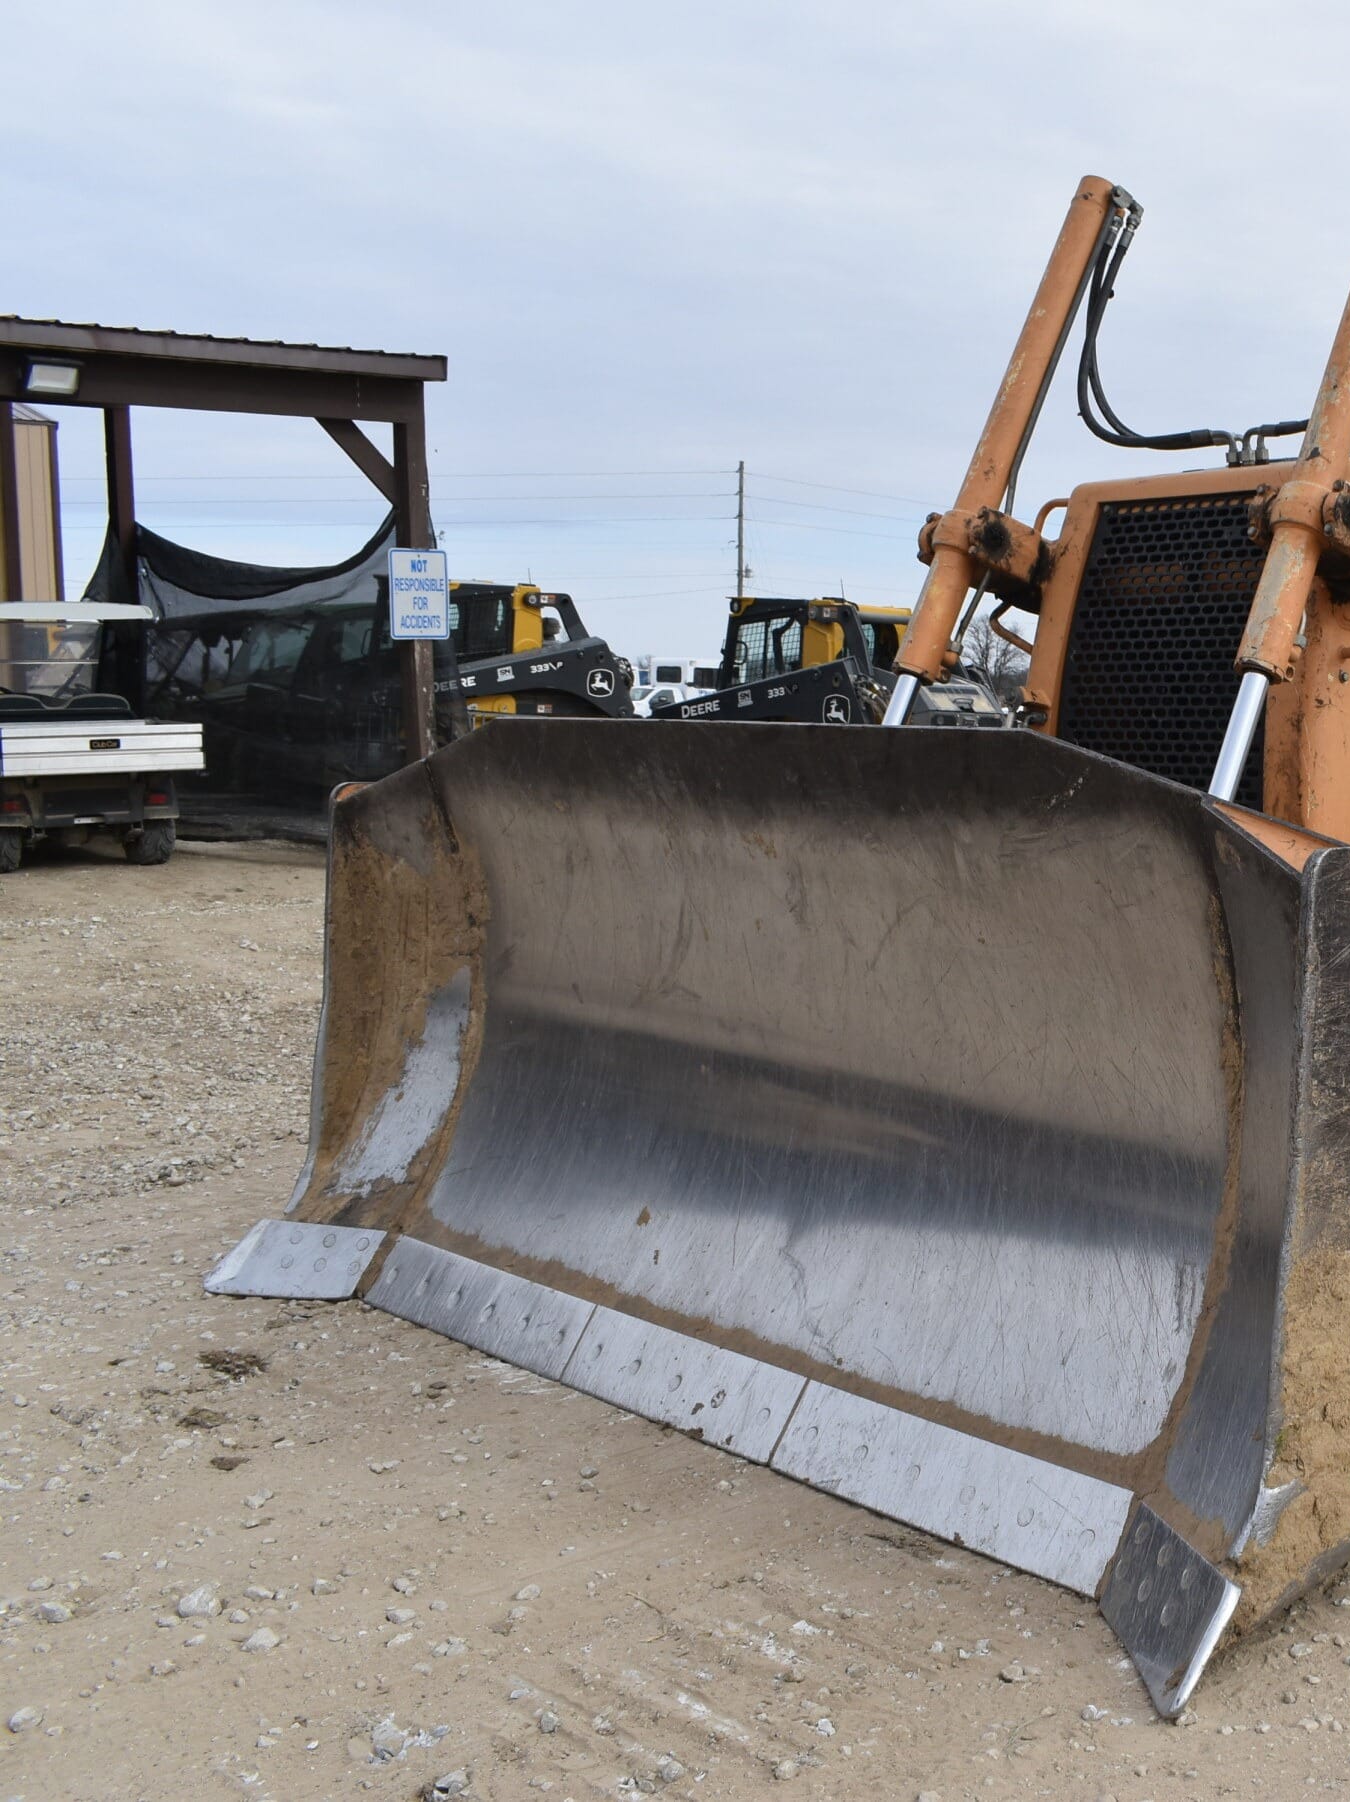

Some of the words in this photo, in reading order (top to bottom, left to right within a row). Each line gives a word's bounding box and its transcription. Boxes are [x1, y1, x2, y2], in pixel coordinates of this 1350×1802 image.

[411, 560, 428, 573] NOT
[394, 578, 445, 592] RESPONSIBLE
[413, 596, 428, 610] FOR
[401, 615, 442, 629] ACCIDENTS
[681, 700, 721, 719] DEERE
